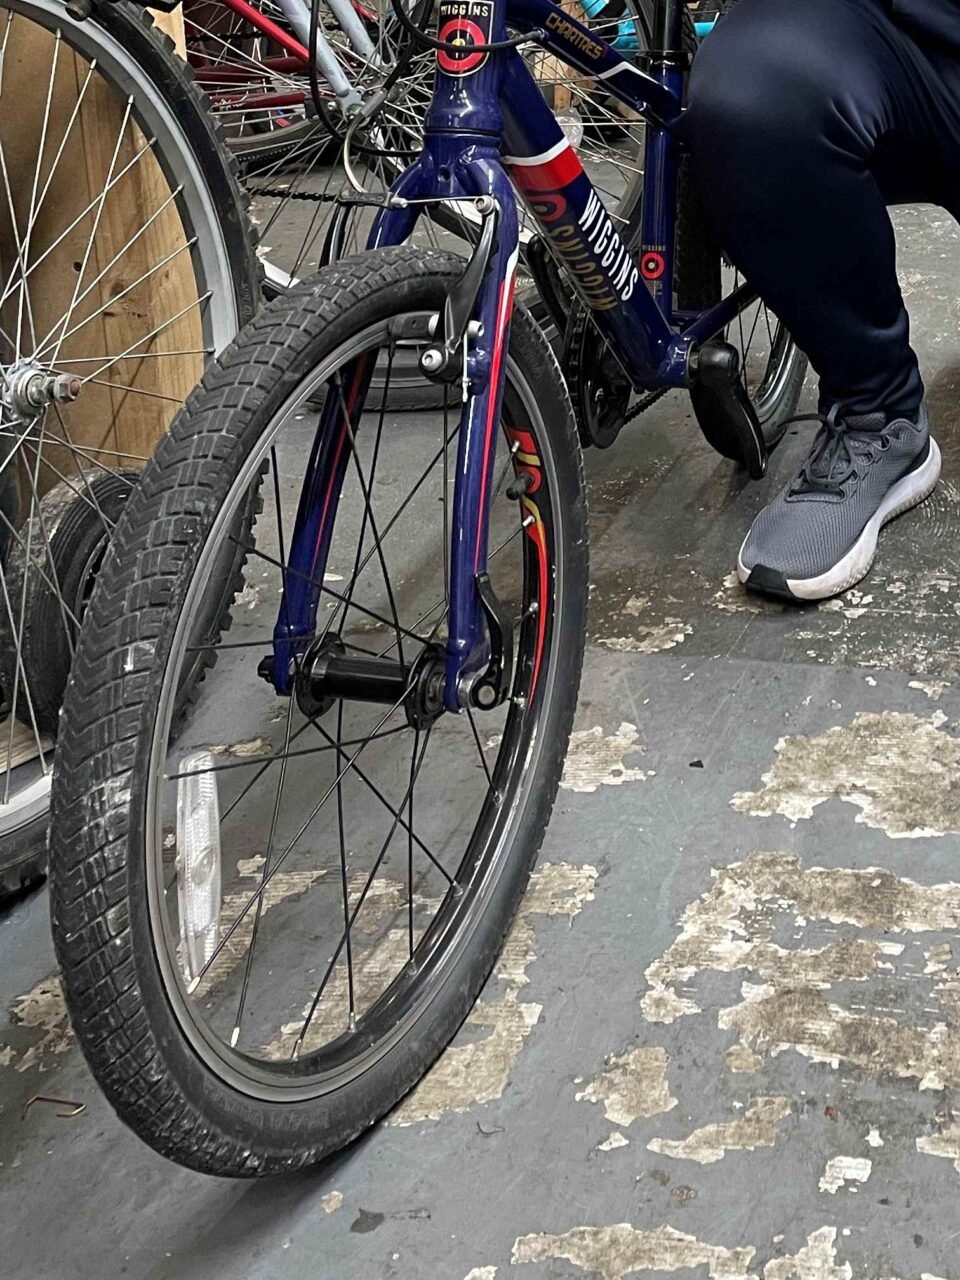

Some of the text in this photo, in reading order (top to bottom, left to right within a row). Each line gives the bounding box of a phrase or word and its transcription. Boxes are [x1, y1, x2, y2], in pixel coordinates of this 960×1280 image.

[440, 4, 489, 17] WIGGINS
[545, 12, 604, 60] CHARTRES
[578, 187, 638, 301] WIGGINS
